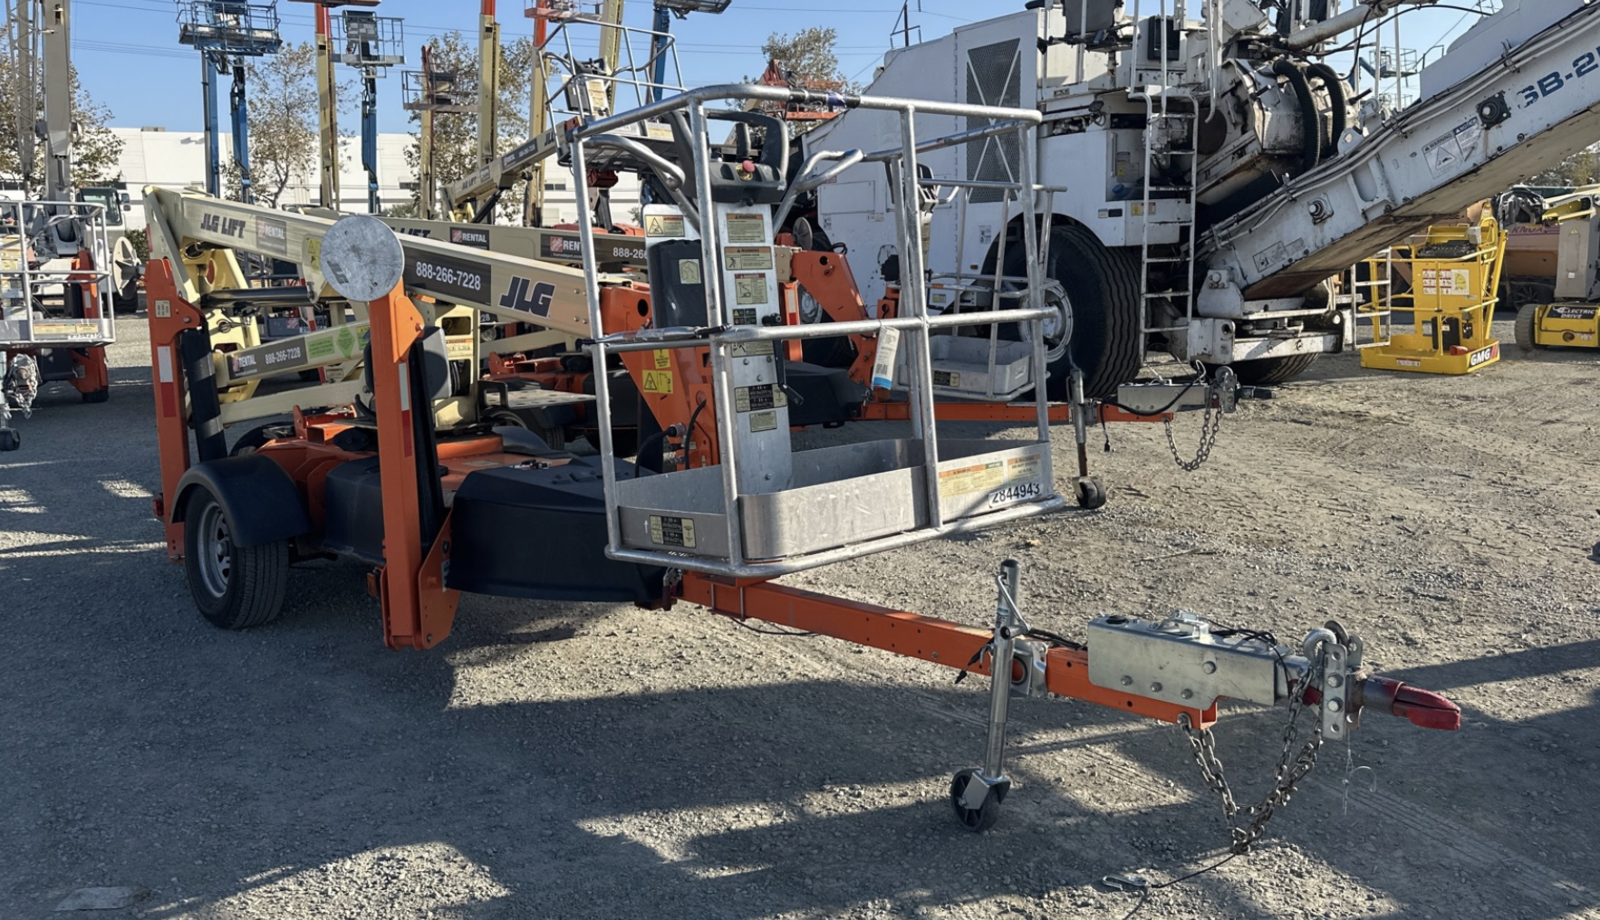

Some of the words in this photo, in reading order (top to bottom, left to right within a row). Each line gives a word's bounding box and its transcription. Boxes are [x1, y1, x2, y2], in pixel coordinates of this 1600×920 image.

[1517, 45, 1600, 109] SB-2
[200, 212, 220, 233] JLG
[221, 217, 246, 239] LIFT
[265, 225, 285, 240] RENTAL
[462, 232, 488, 243] RENTAL
[415, 261, 481, 291] 888-266-7228
[498, 275, 556, 318] JLG
[238, 354, 257, 366] RENTAL
[265, 346, 301, 365] 888-266-7228
[1470, 348, 1491, 366] GMG
[991, 482, 1040, 504] 2844943
